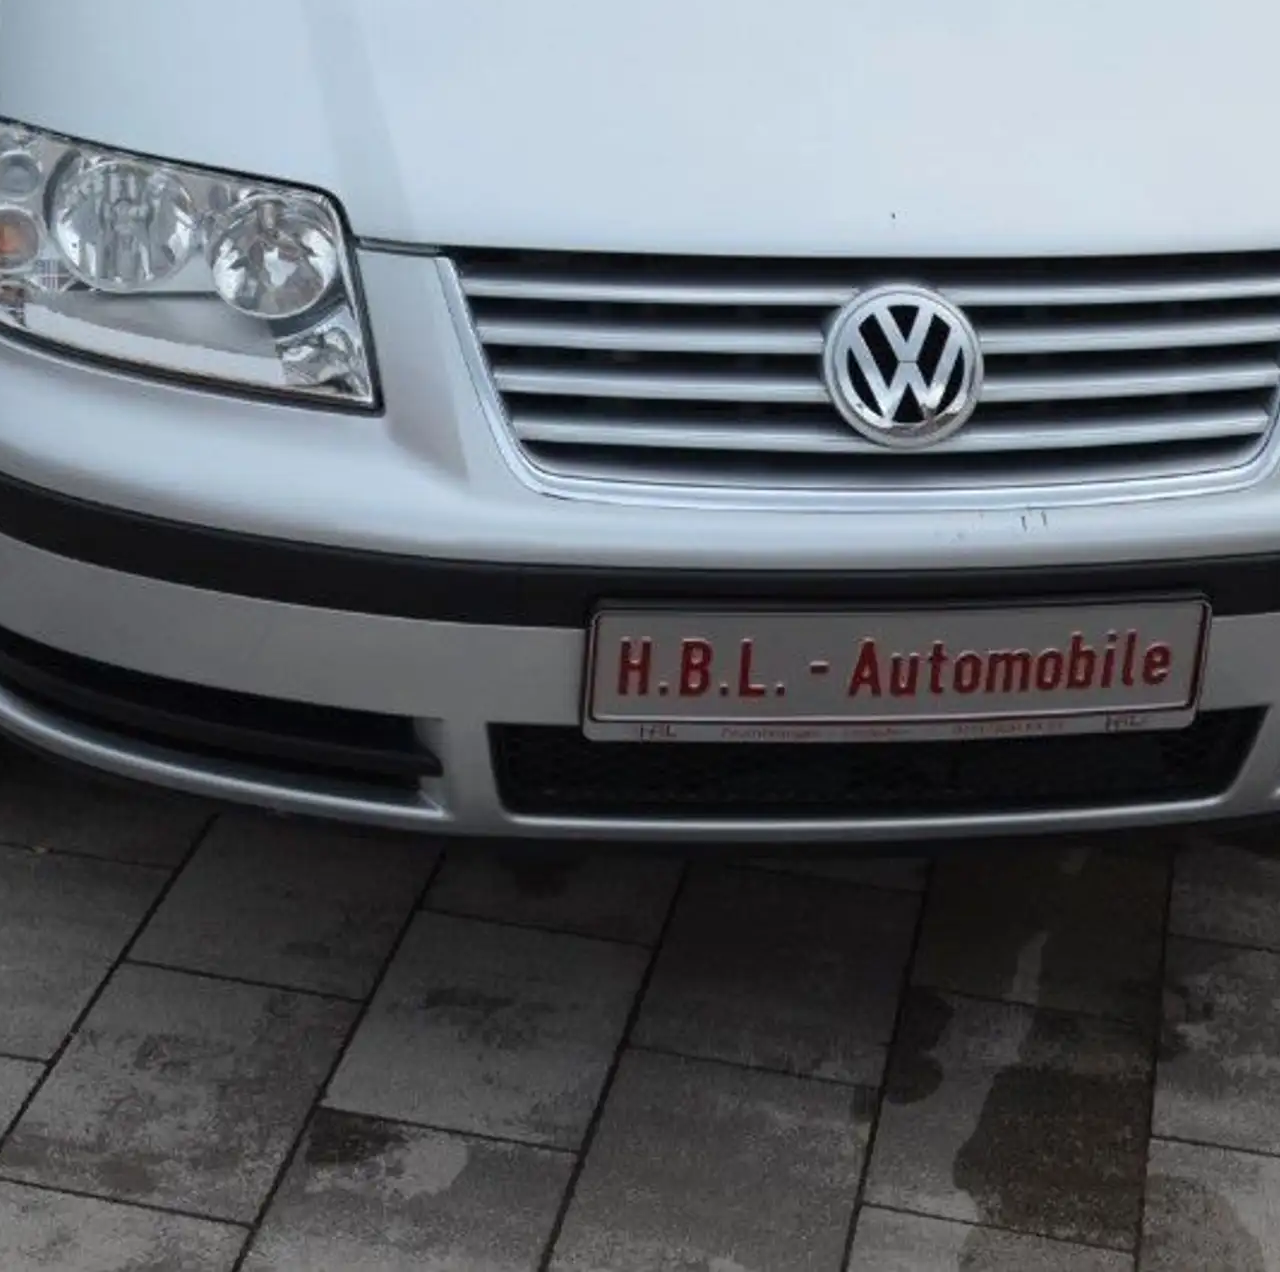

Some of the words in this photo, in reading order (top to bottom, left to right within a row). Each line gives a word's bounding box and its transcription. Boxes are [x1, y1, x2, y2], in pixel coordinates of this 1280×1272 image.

[840, 293, 970, 434] VW
[617, 636, 786, 697] H.B.L.
[809, 660, 830, 675] -
[847, 628, 1173, 698] Automobile
